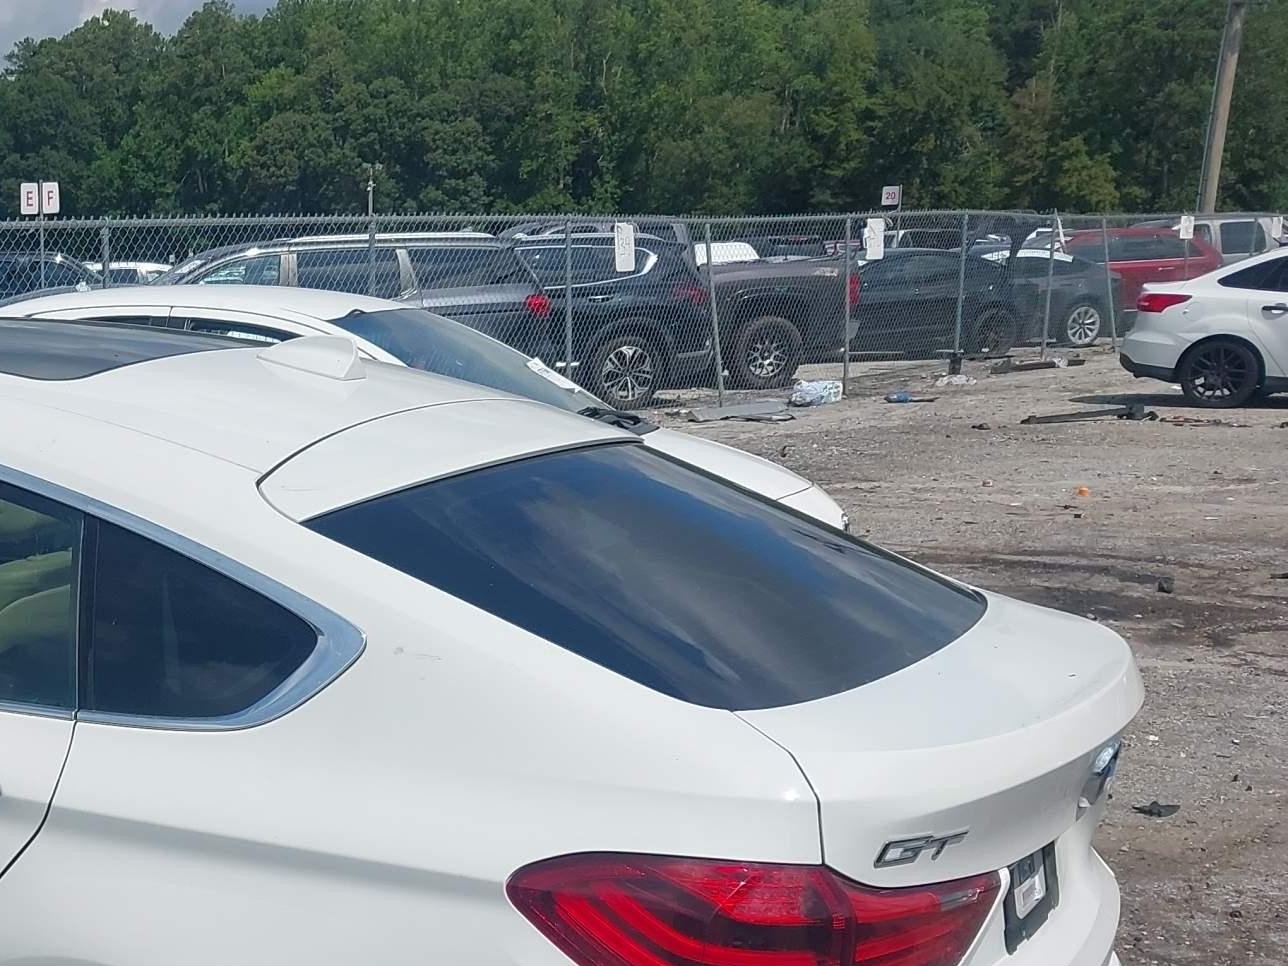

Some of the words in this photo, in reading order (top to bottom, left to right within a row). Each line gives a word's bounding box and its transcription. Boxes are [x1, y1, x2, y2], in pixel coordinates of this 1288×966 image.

[26, 190, 34, 207] E
[47, 190, 54, 206] F
[885, 191, 896, 200] 20
[873, 830, 969, 869] GT
